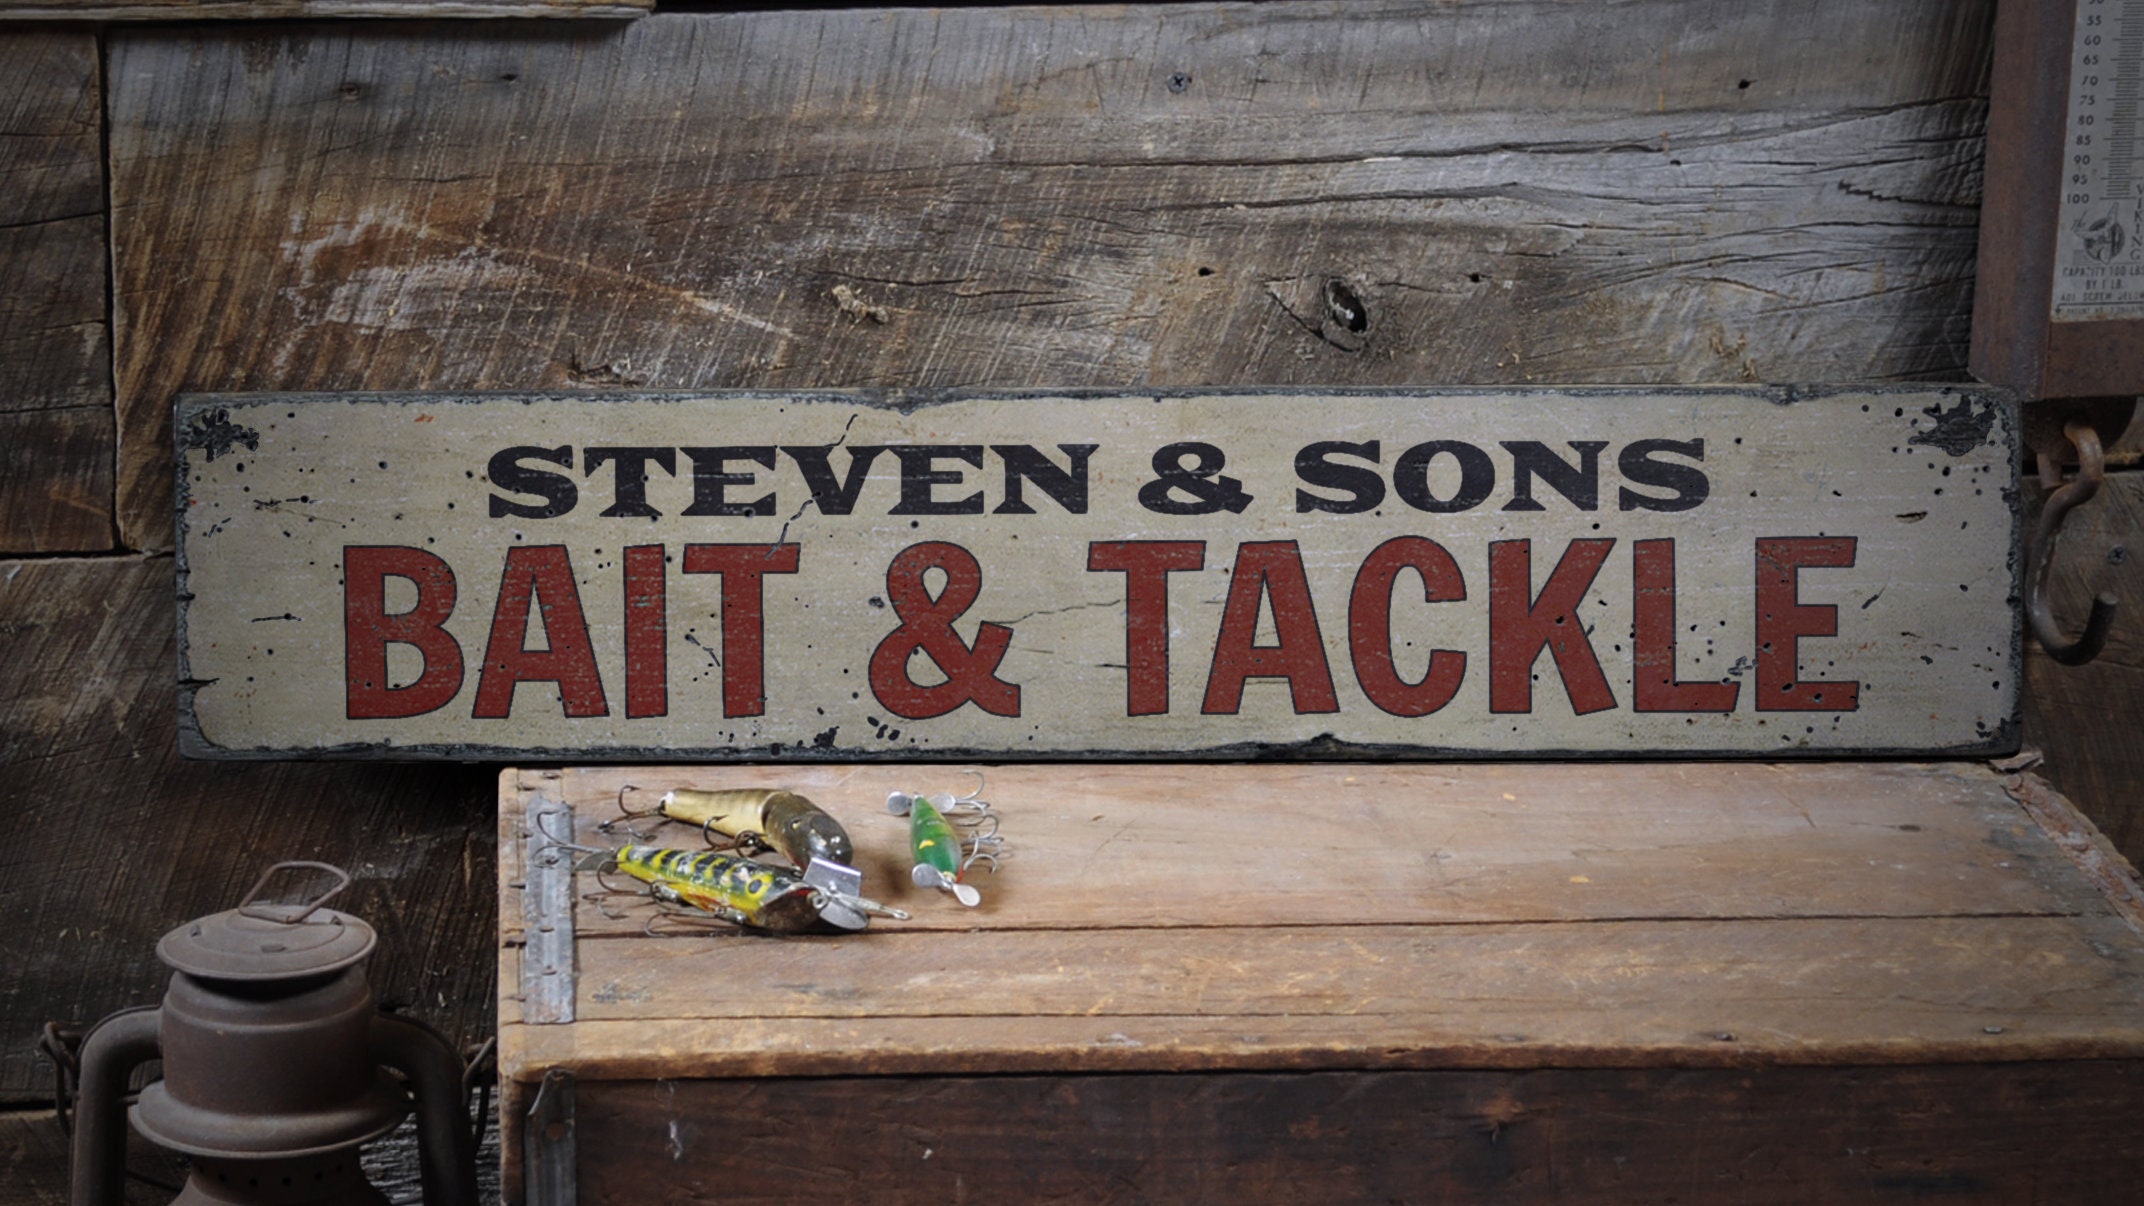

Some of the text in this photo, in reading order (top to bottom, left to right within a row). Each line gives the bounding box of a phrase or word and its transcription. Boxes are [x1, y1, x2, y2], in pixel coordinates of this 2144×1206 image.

[2087, 15, 2101, 26] 55
[2084, 35, 2101, 46] 60
[2083, 54, 2099, 65] 65
[2081, 75, 2098, 86] 70
[2080, 95, 2095, 105] 75
[2078, 115, 2094, 126] 80
[2076, 135, 2091, 146] 85
[2074, 154, 2090, 165] 90
[2072, 174, 2088, 185] 95
[2067, 193, 2089, 204] 100
[487, 437, 1711, 520] STEVEN & SONS
[344, 536, 1861, 719] BAIT & TACKLE
